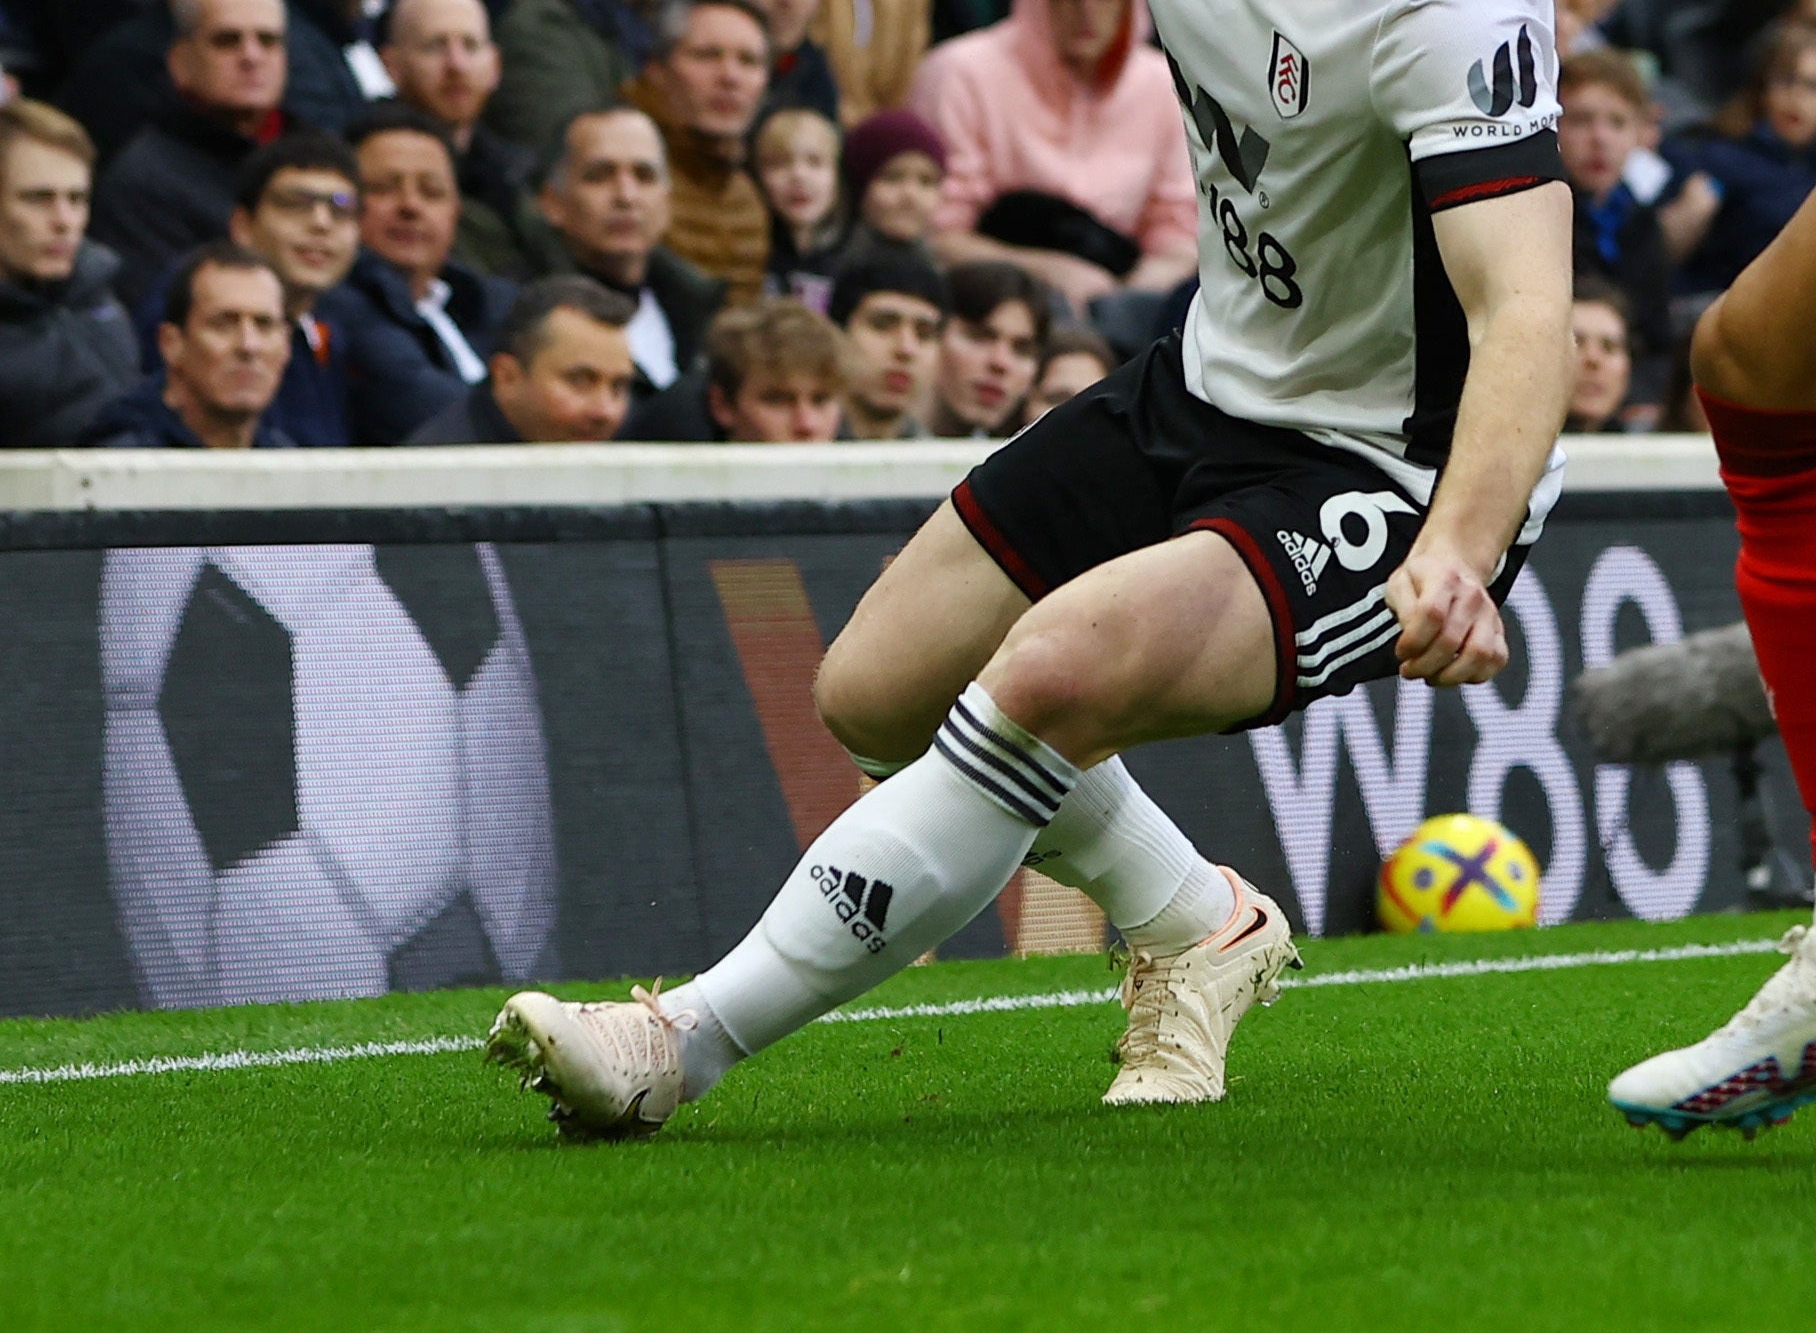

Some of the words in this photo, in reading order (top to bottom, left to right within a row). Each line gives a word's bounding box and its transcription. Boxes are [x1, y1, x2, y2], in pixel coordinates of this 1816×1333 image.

[1278, 53, 1299, 104] FFC
[1453, 125, 1522, 138] WORLD
[1276, 529, 1317, 597] adidas
[1319, 490, 1420, 571] 6
[810, 864, 887, 954] adidas
